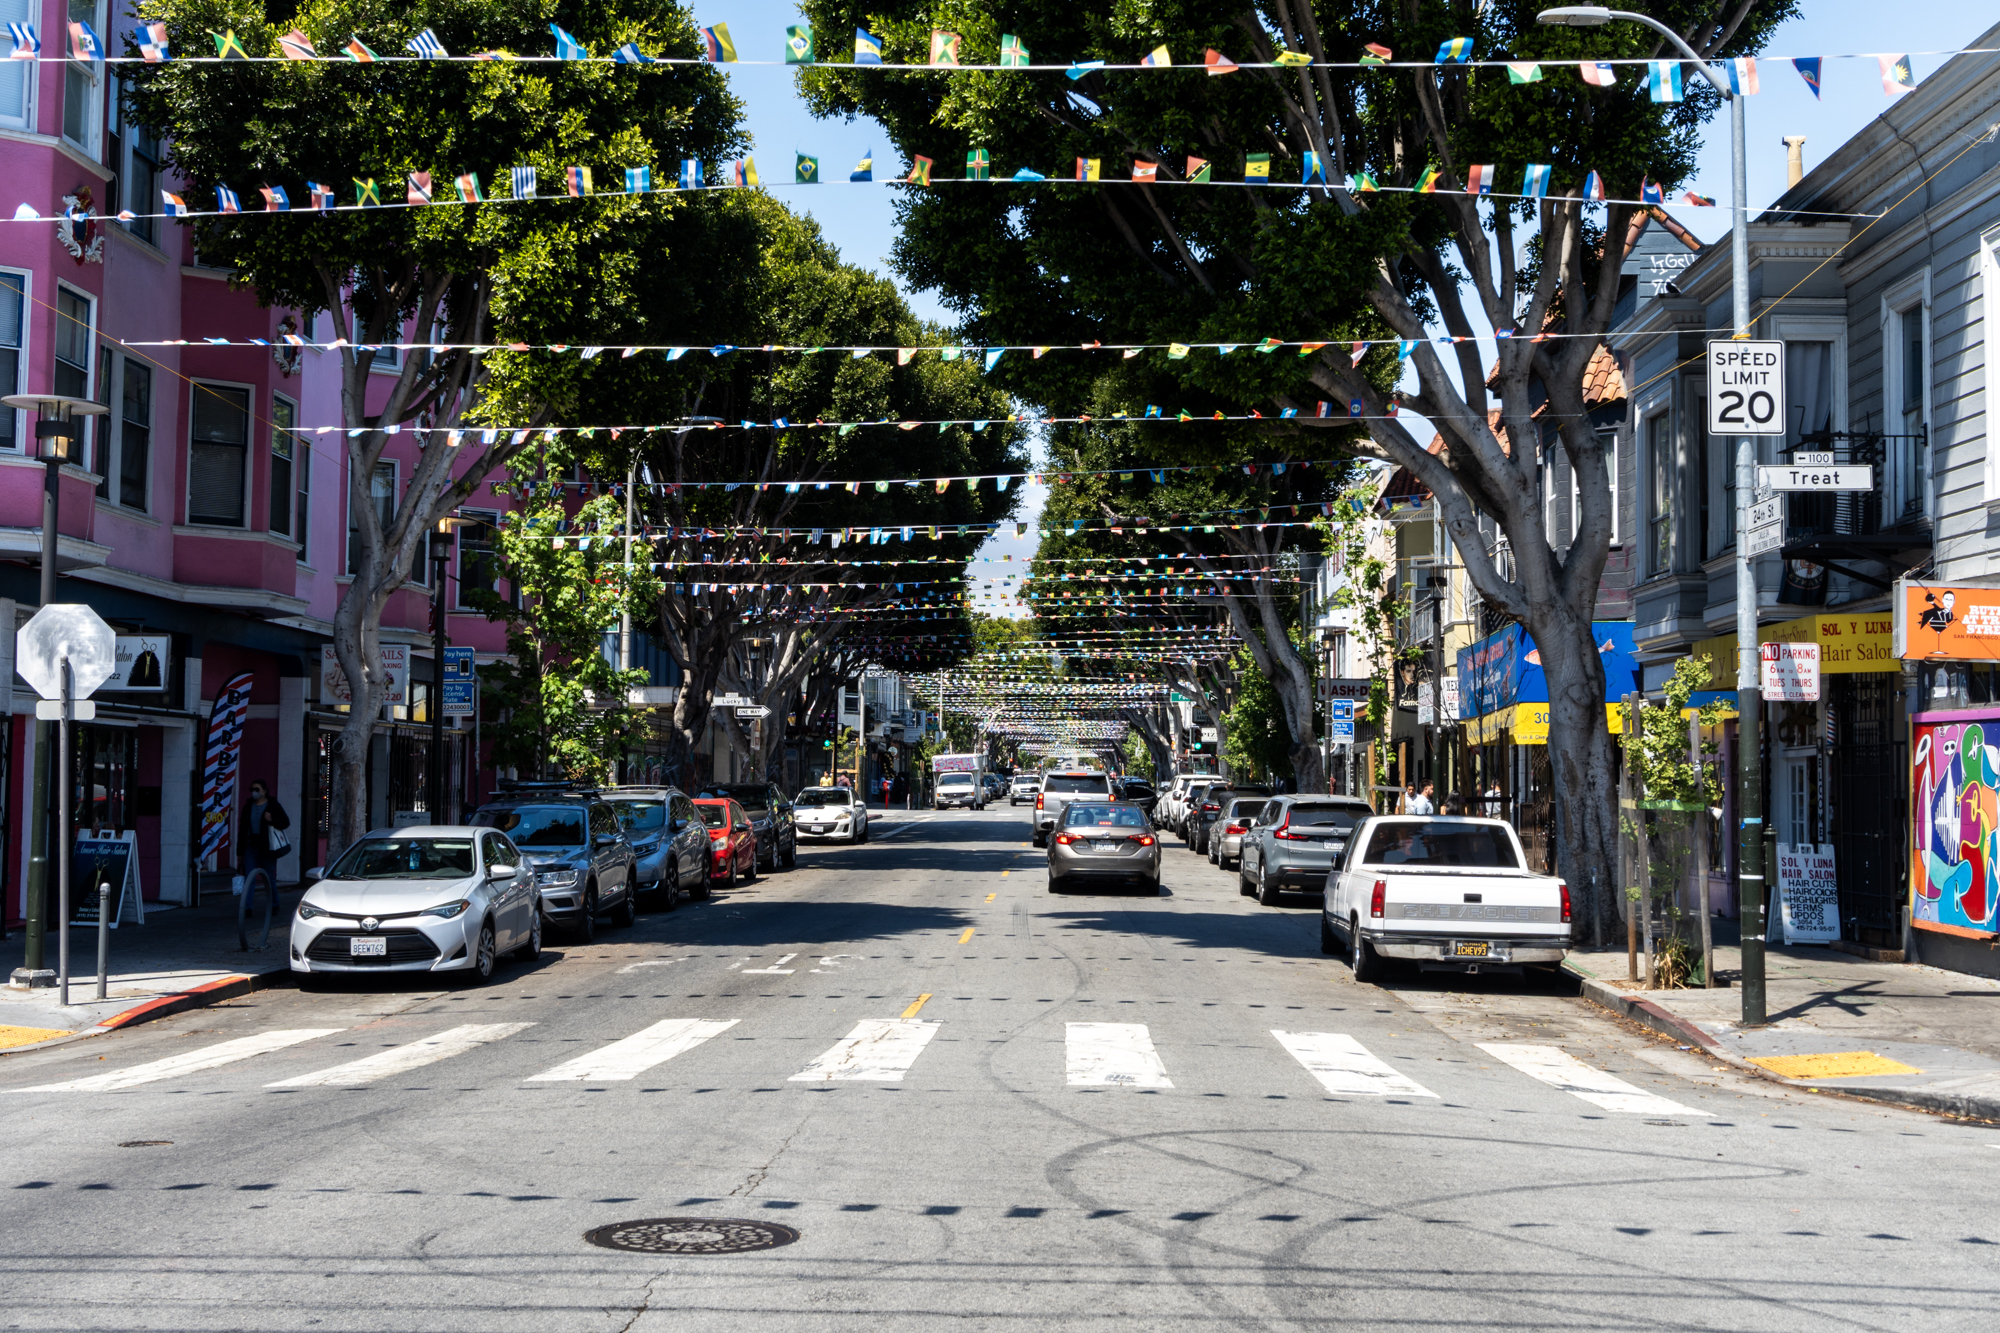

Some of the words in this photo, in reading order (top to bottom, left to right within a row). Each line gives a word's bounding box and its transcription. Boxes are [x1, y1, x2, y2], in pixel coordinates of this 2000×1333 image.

[1716, 353, 1777, 366] SPEED
[1723, 372, 1770, 385] LIMIT
[1718, 391, 1775, 424] 20
[1808, 454, 1829, 463] 1100
[1790, 472, 1840, 485] Treat
[1768, 503, 1774, 518] St
[1962, 615, 1979, 625] AT
[1822, 623, 1841, 637] SOL
[1850, 622, 1857, 634] Y
[1865, 621, 1893, 635] LUNA
[381, 649, 404, 660] AILS
[1764, 645, 1779, 660] NO
[1782, 649, 1816, 660] PARKING
[1820, 644, 1851, 661] Hair
[1769, 678, 1786, 688] TUES
[1791, 678, 1813, 688] THURS
[1320, 684, 1371, 697] WASH-D
[213, 688, 242, 807] BARBER
[111, 844, 127, 855] Salon
[1781, 857, 1798, 868] SOL
[1804, 858, 1809, 868] Y
[1813, 858, 1834, 869] LUNA
[1782, 868, 1802, 879] HAIR
[1809, 869, 1835, 880] SALON
[1788, 879, 1810, 888] HAIR
[1812, 880, 1837, 888] CUTS
[1789, 888, 1837, 897] HAIRCOLOR
[1403, 904, 1544, 920] CHEVROLET
[1790, 904, 1824, 912] PERMS
[1791, 911, 1824, 920] UPDOS
[353, 944, 384, 953] 8EEW762
[1456, 946, 1487, 956] 1CHEV93
